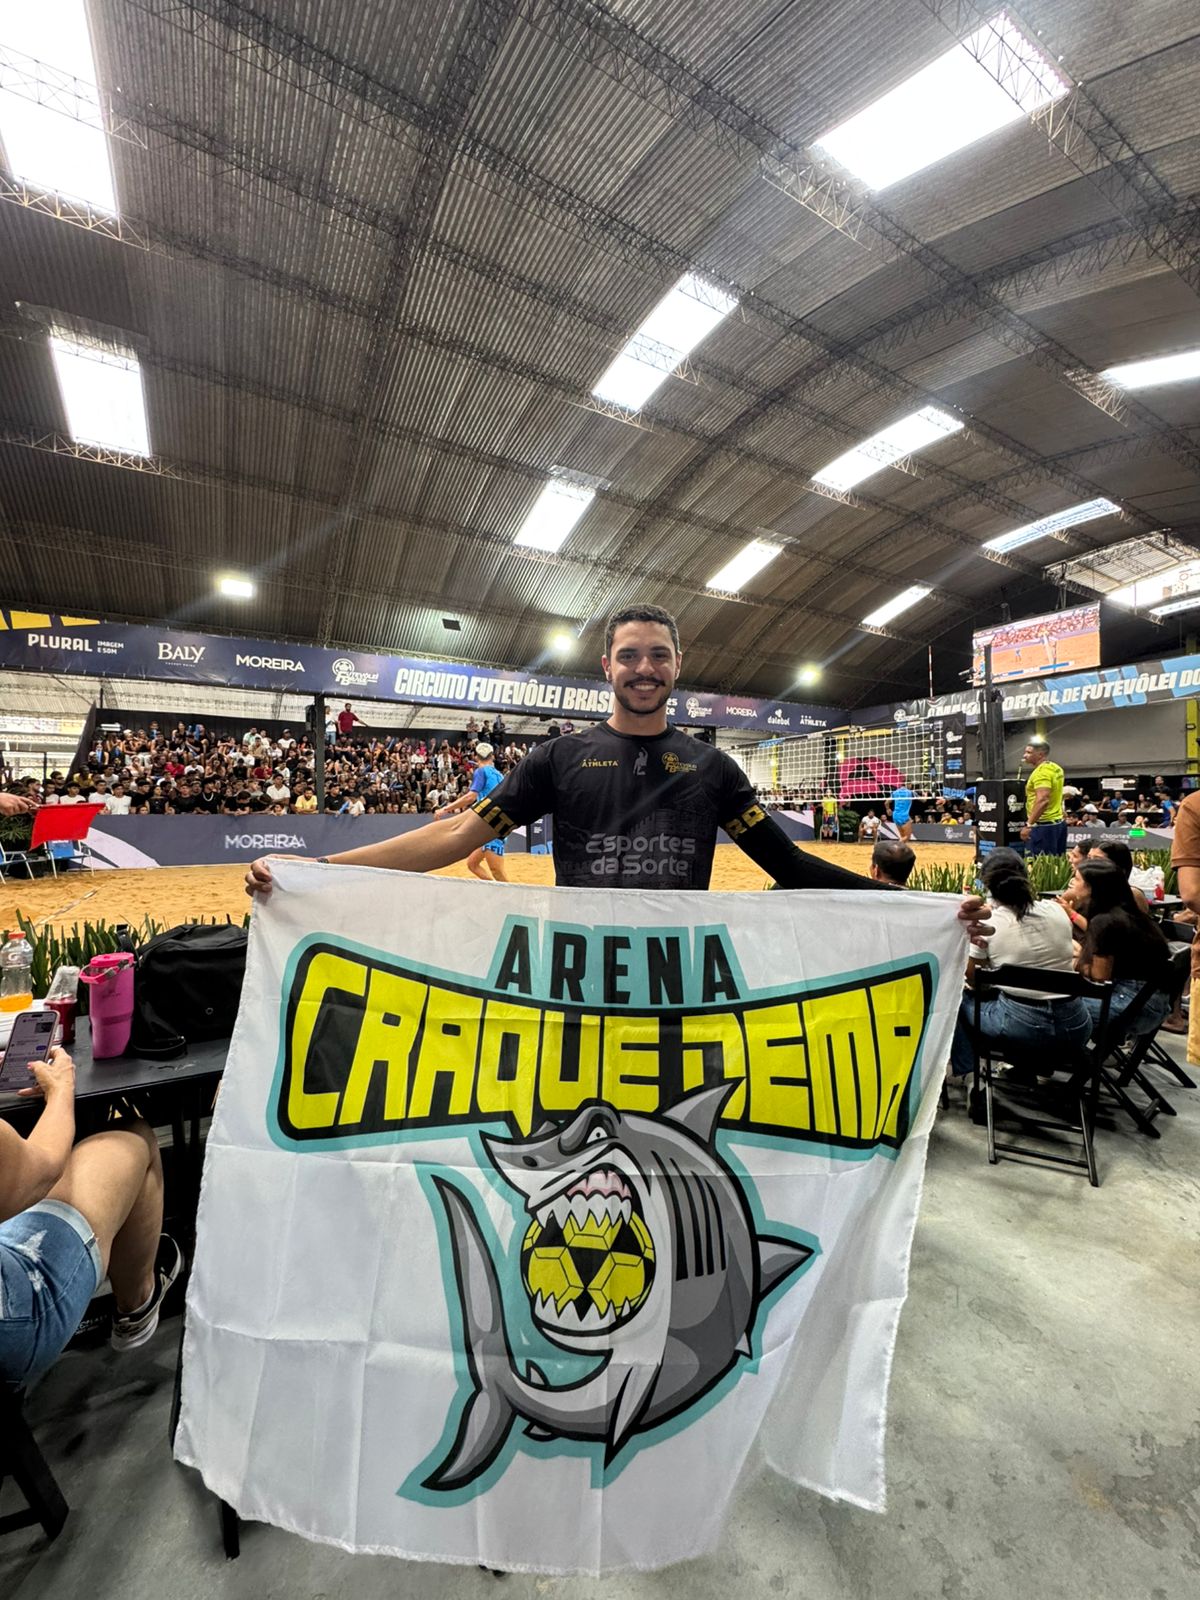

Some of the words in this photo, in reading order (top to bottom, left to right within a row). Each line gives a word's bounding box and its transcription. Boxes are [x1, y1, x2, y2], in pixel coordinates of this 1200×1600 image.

[27, 633, 93, 652] PLURAL
[97, 640, 124, 649] IMAGEM
[236, 654, 305, 672] MOREIRA
[394, 668, 468, 700] CIRCUITO
[468, 676, 561, 709] FUTEVÔLEI
[562, 687, 614, 713] BRASI
[1002, 689, 1059, 711] ORTAL
[1062, 686, 1081, 704] DE
[1081, 671, 1178, 700] FUTEVÔLEI
[726, 706, 758, 718] MOREIRA
[581, 760, 618, 768] ATHLETA
[585, 832, 696, 856] Esportes
[590, 855, 619, 875] da
[622, 854, 688, 876] Sorte
[494, 925, 741, 1004] ARENA
